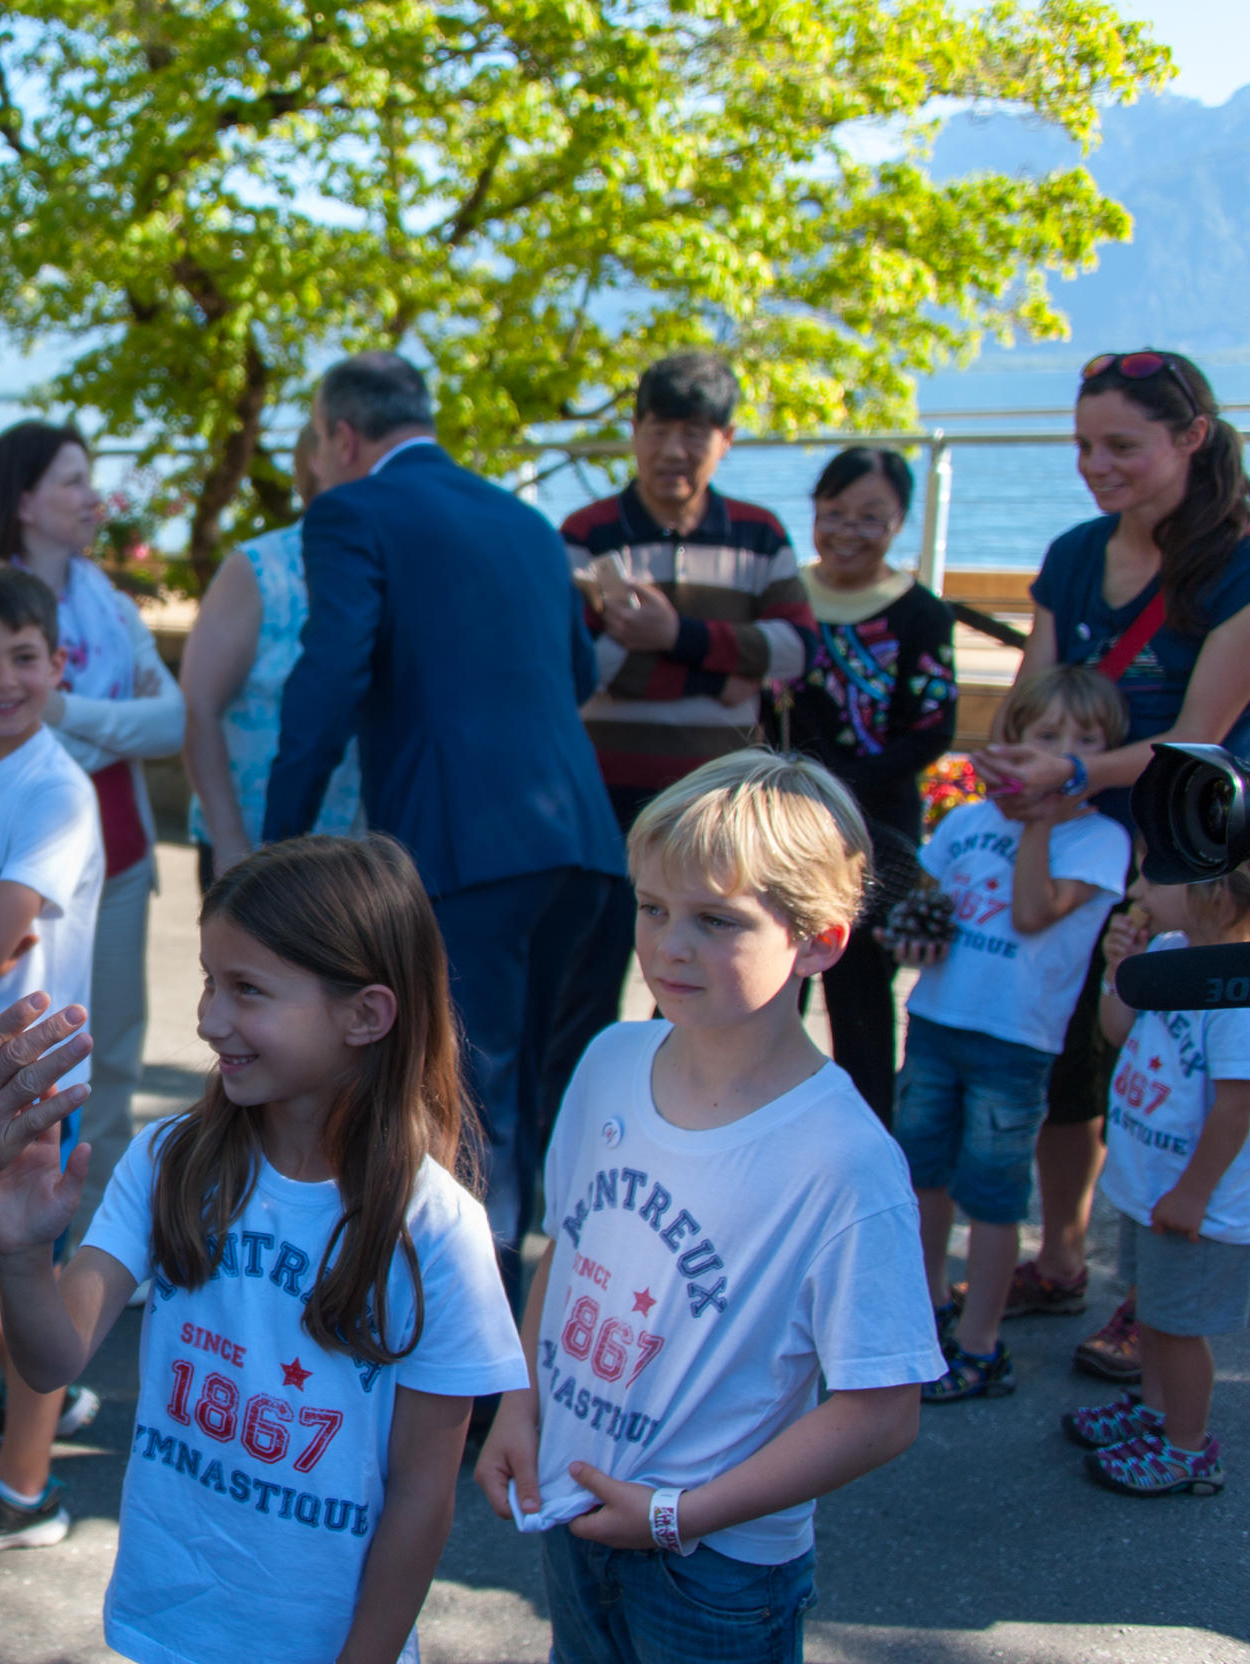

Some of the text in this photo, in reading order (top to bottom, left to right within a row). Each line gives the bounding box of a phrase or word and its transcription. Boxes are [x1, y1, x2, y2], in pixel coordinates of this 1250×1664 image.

[179, 1321, 248, 1369] SINCE
[560, 1284, 665, 1390] 867
[166, 1359, 344, 1474] 1867
